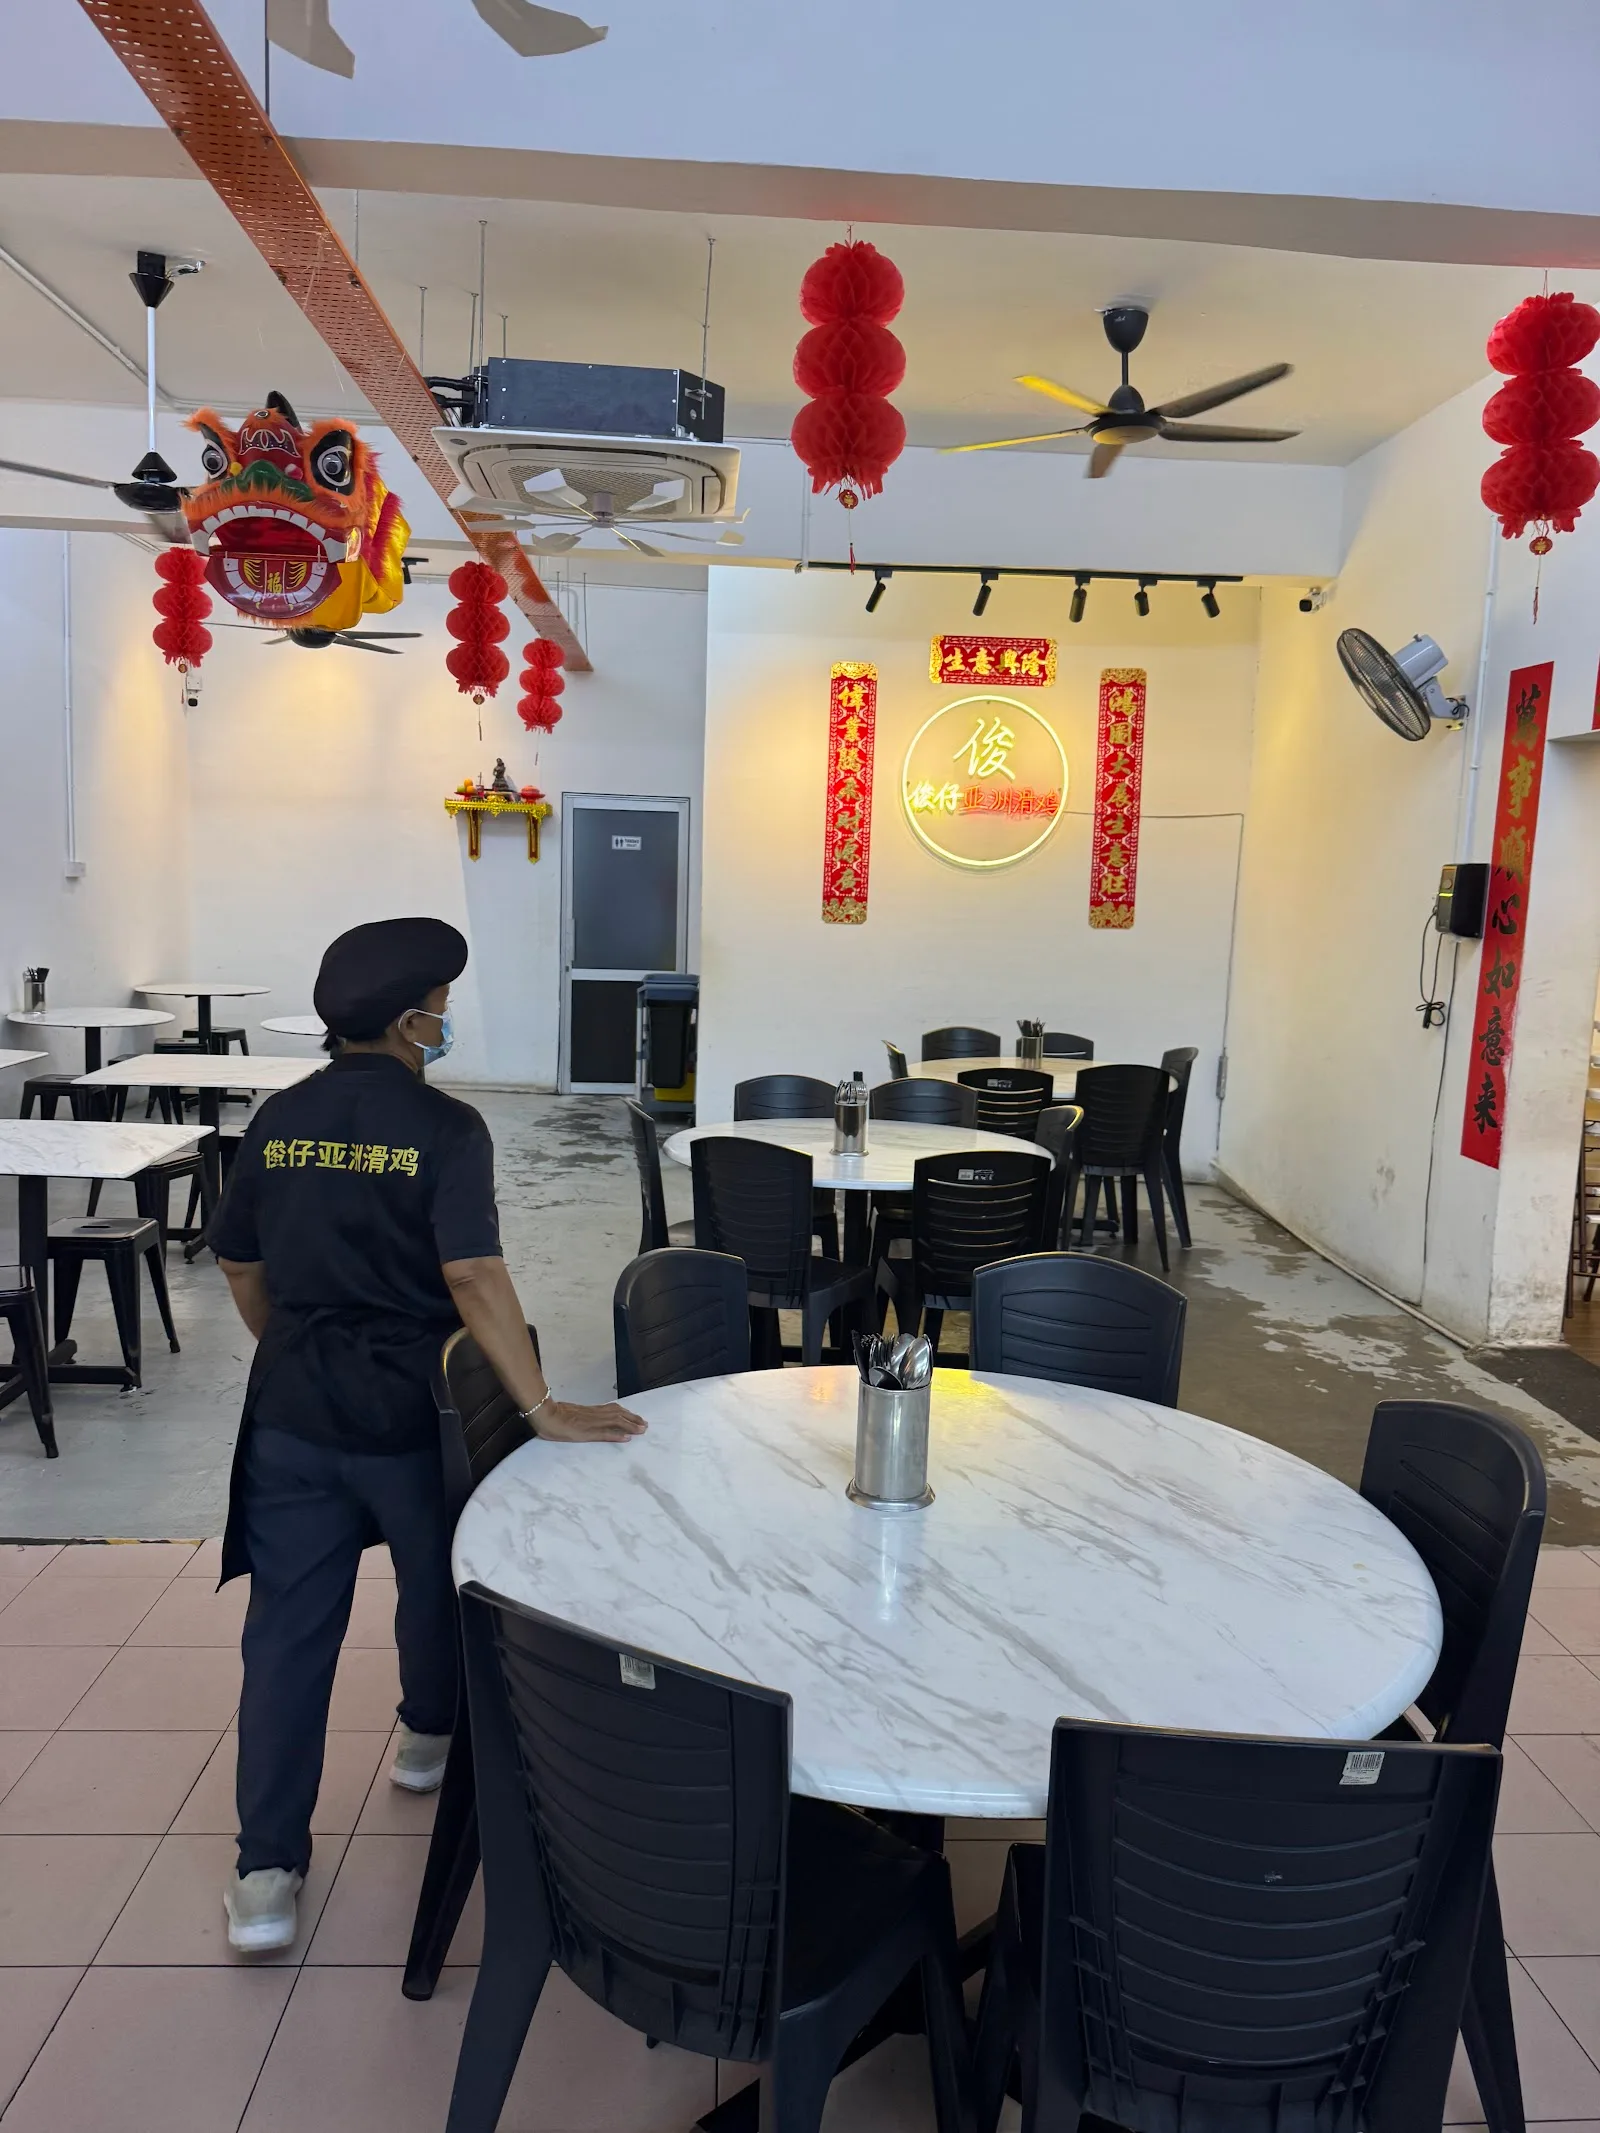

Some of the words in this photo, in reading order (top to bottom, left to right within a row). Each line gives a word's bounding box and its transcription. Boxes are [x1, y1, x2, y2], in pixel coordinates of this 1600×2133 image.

[267, 572, 283, 594] 福
[943, 647, 1048, 676] 生意興隆
[953, 716, 1016, 781] 俊
[907, 781, 1060, 816] 俊仔亚洲滑鸡
